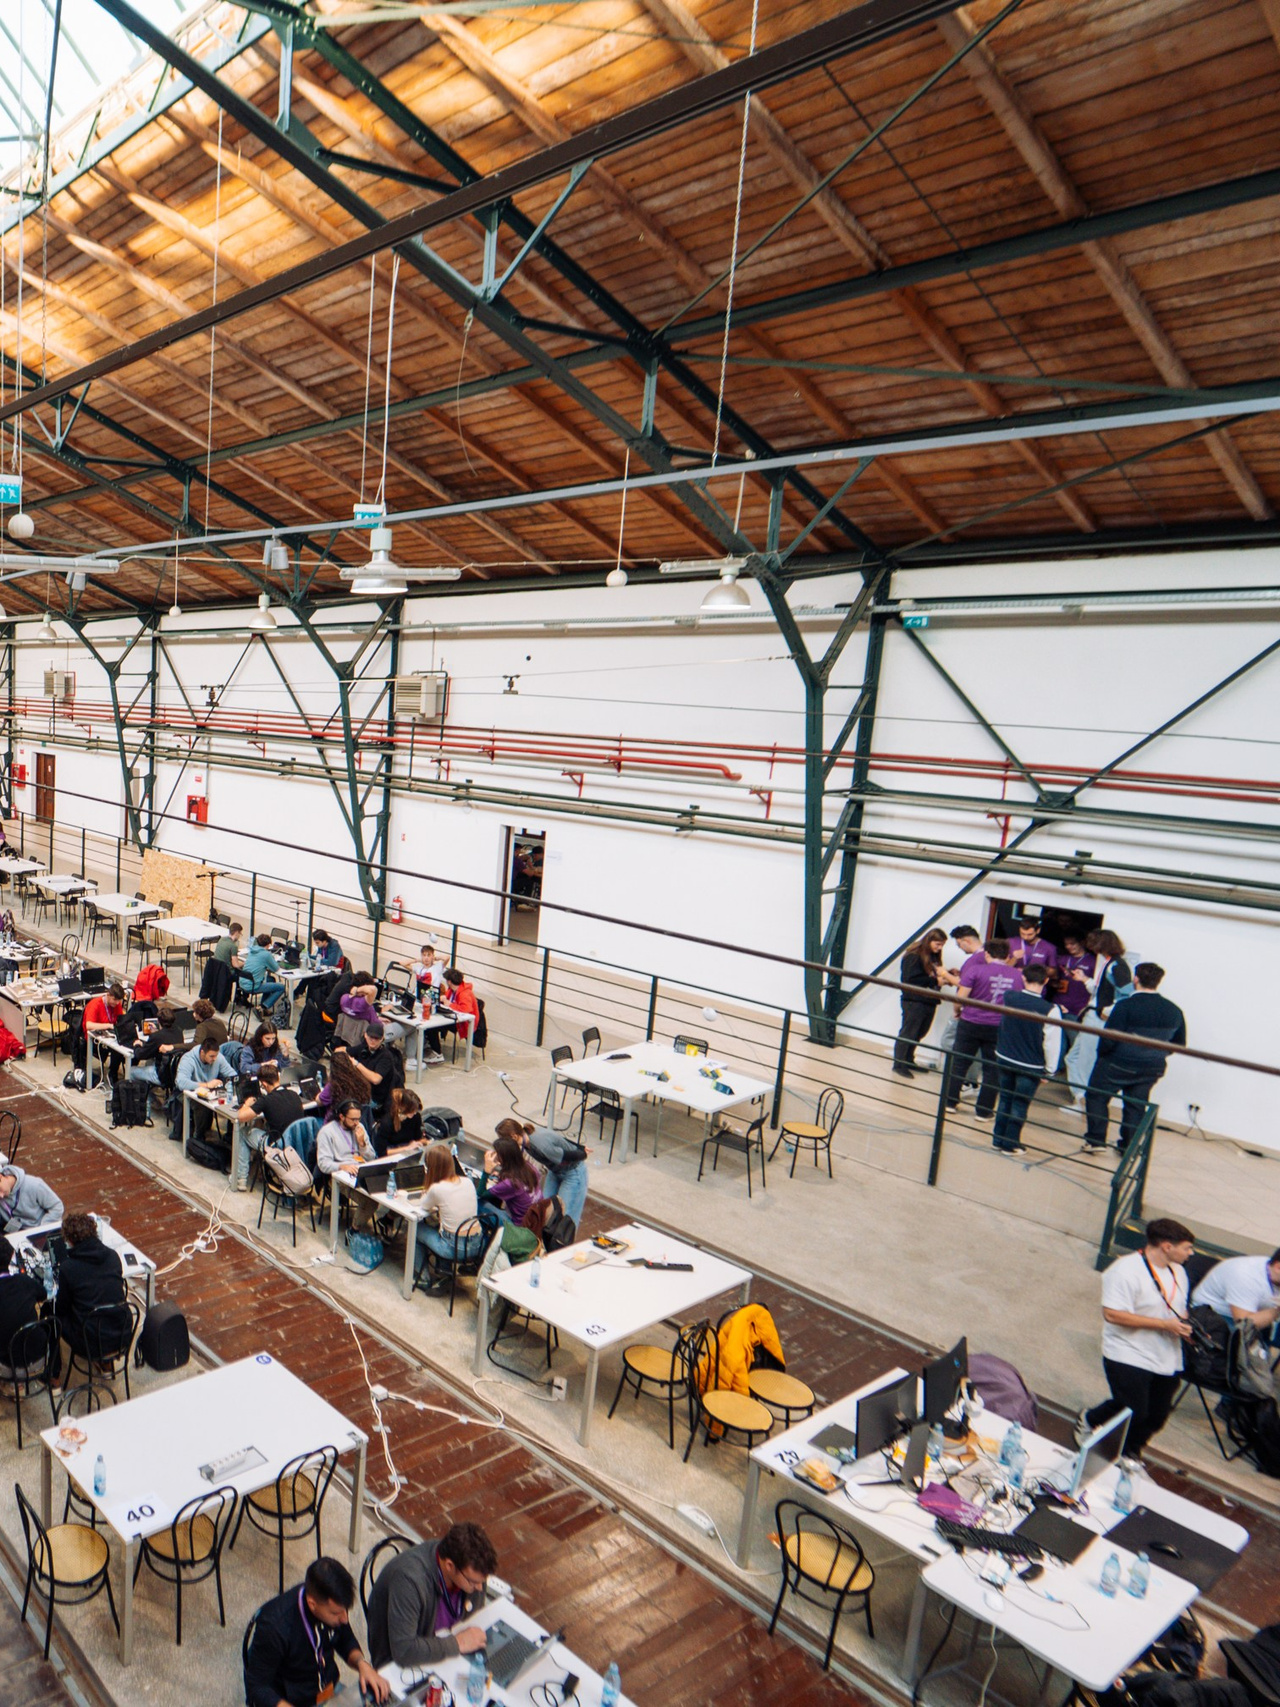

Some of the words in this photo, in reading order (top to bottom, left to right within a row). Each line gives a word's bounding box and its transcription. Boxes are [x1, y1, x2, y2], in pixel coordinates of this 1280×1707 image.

[586, 1324, 607, 1336] 43
[773, 1449, 800, 1466] 42
[127, 1504, 155, 1522] 40
